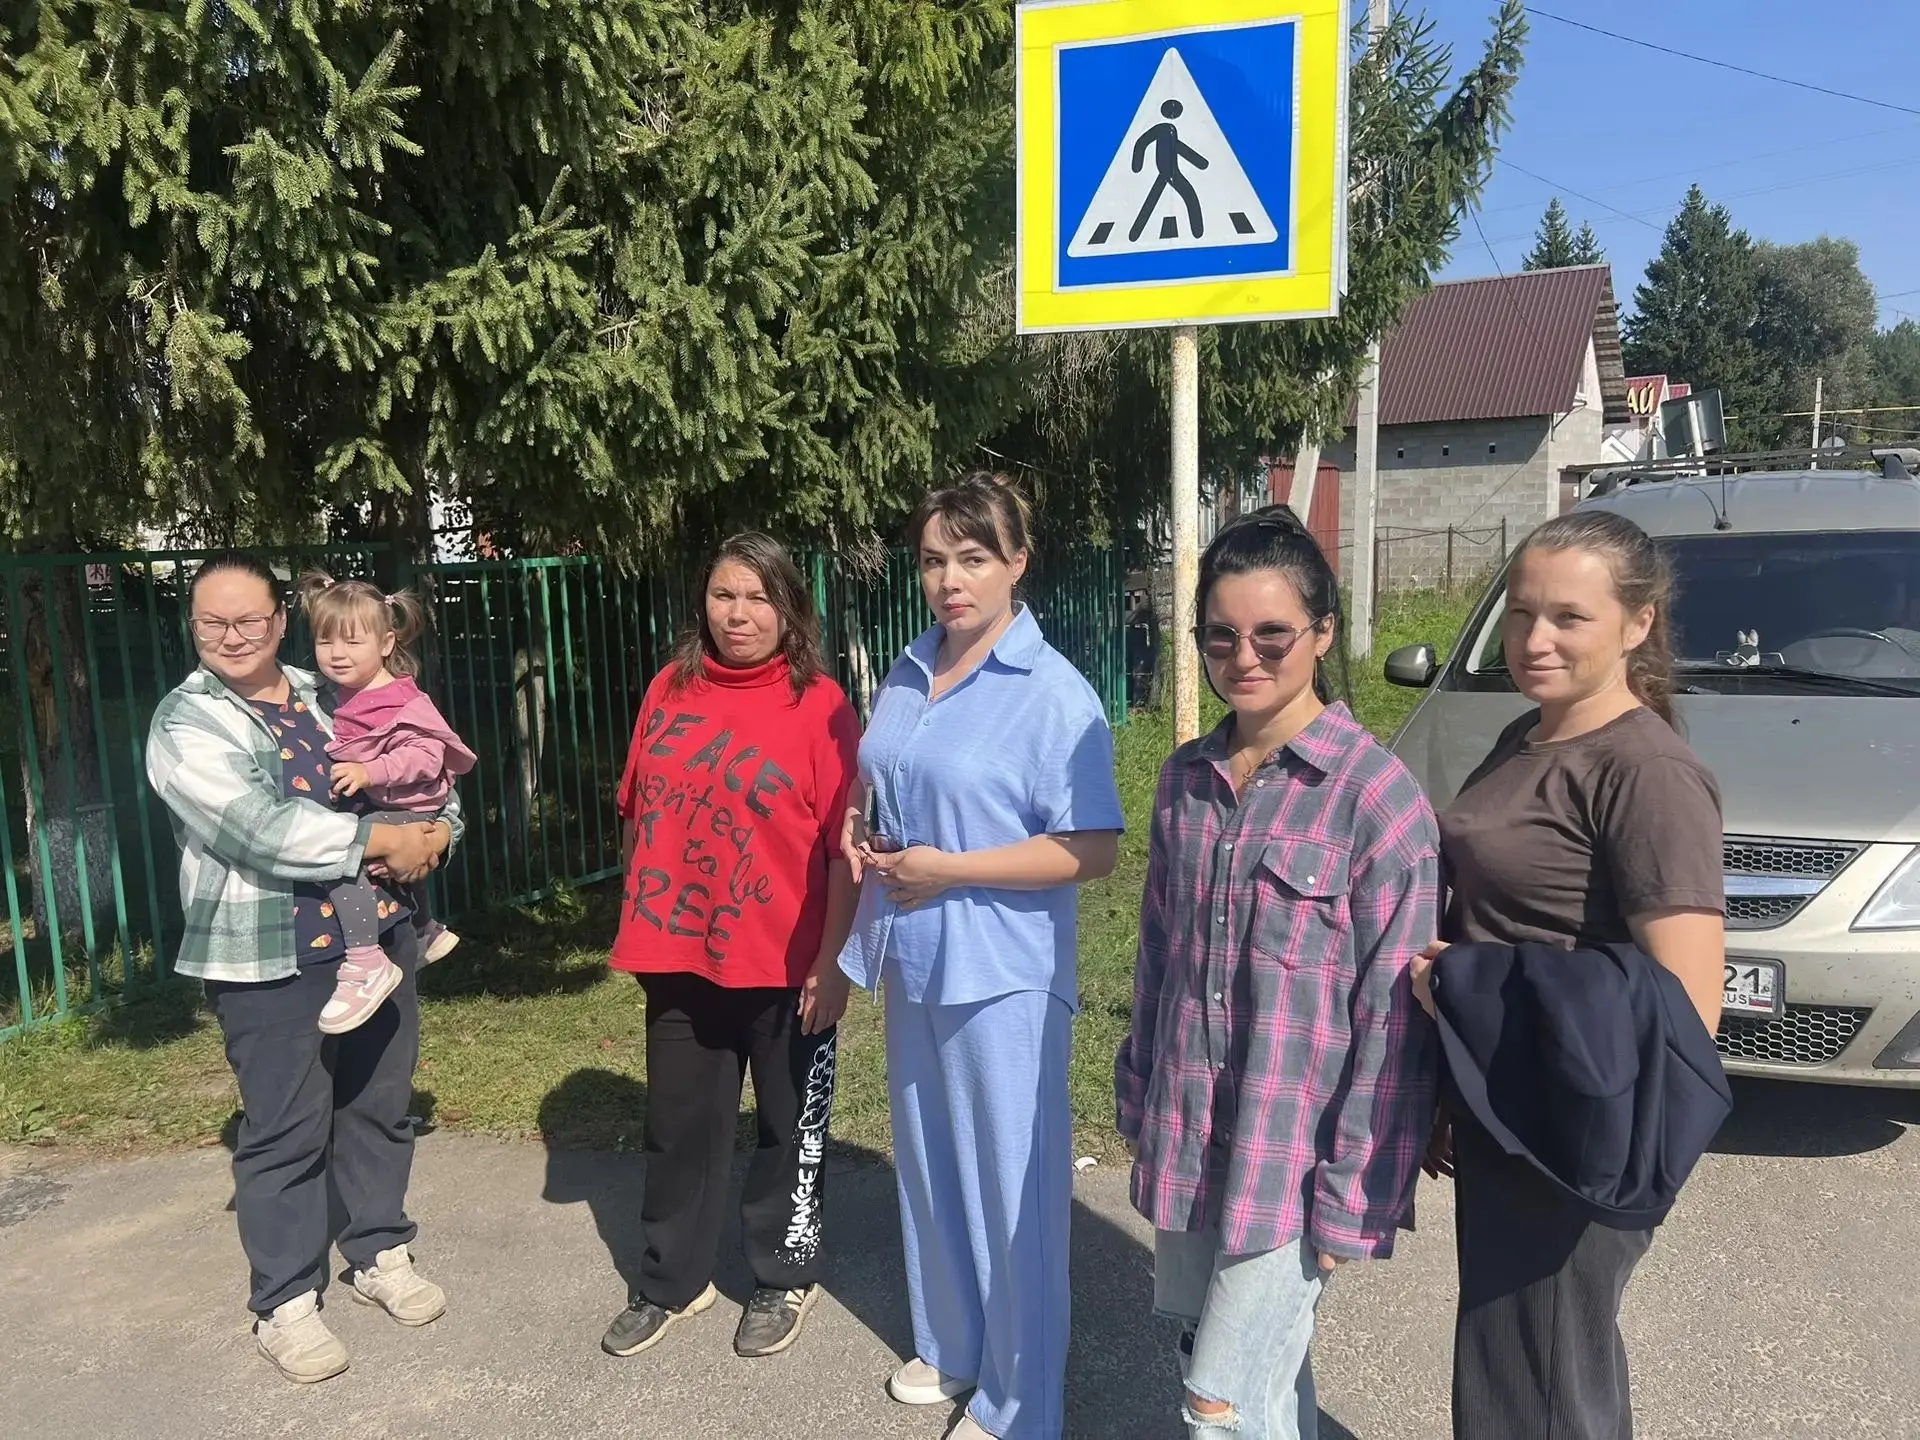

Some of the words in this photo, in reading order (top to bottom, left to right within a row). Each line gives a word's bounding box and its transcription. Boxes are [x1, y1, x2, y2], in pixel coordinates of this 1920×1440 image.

[643, 707, 795, 820] PEACE
[683, 838, 718, 877] to
[729, 853, 774, 905] be
[624, 866, 742, 962] REE
[1722, 993, 1748, 1005] US
[799, 1130, 824, 1165] THE
[785, 1168, 819, 1248] CHANGE
